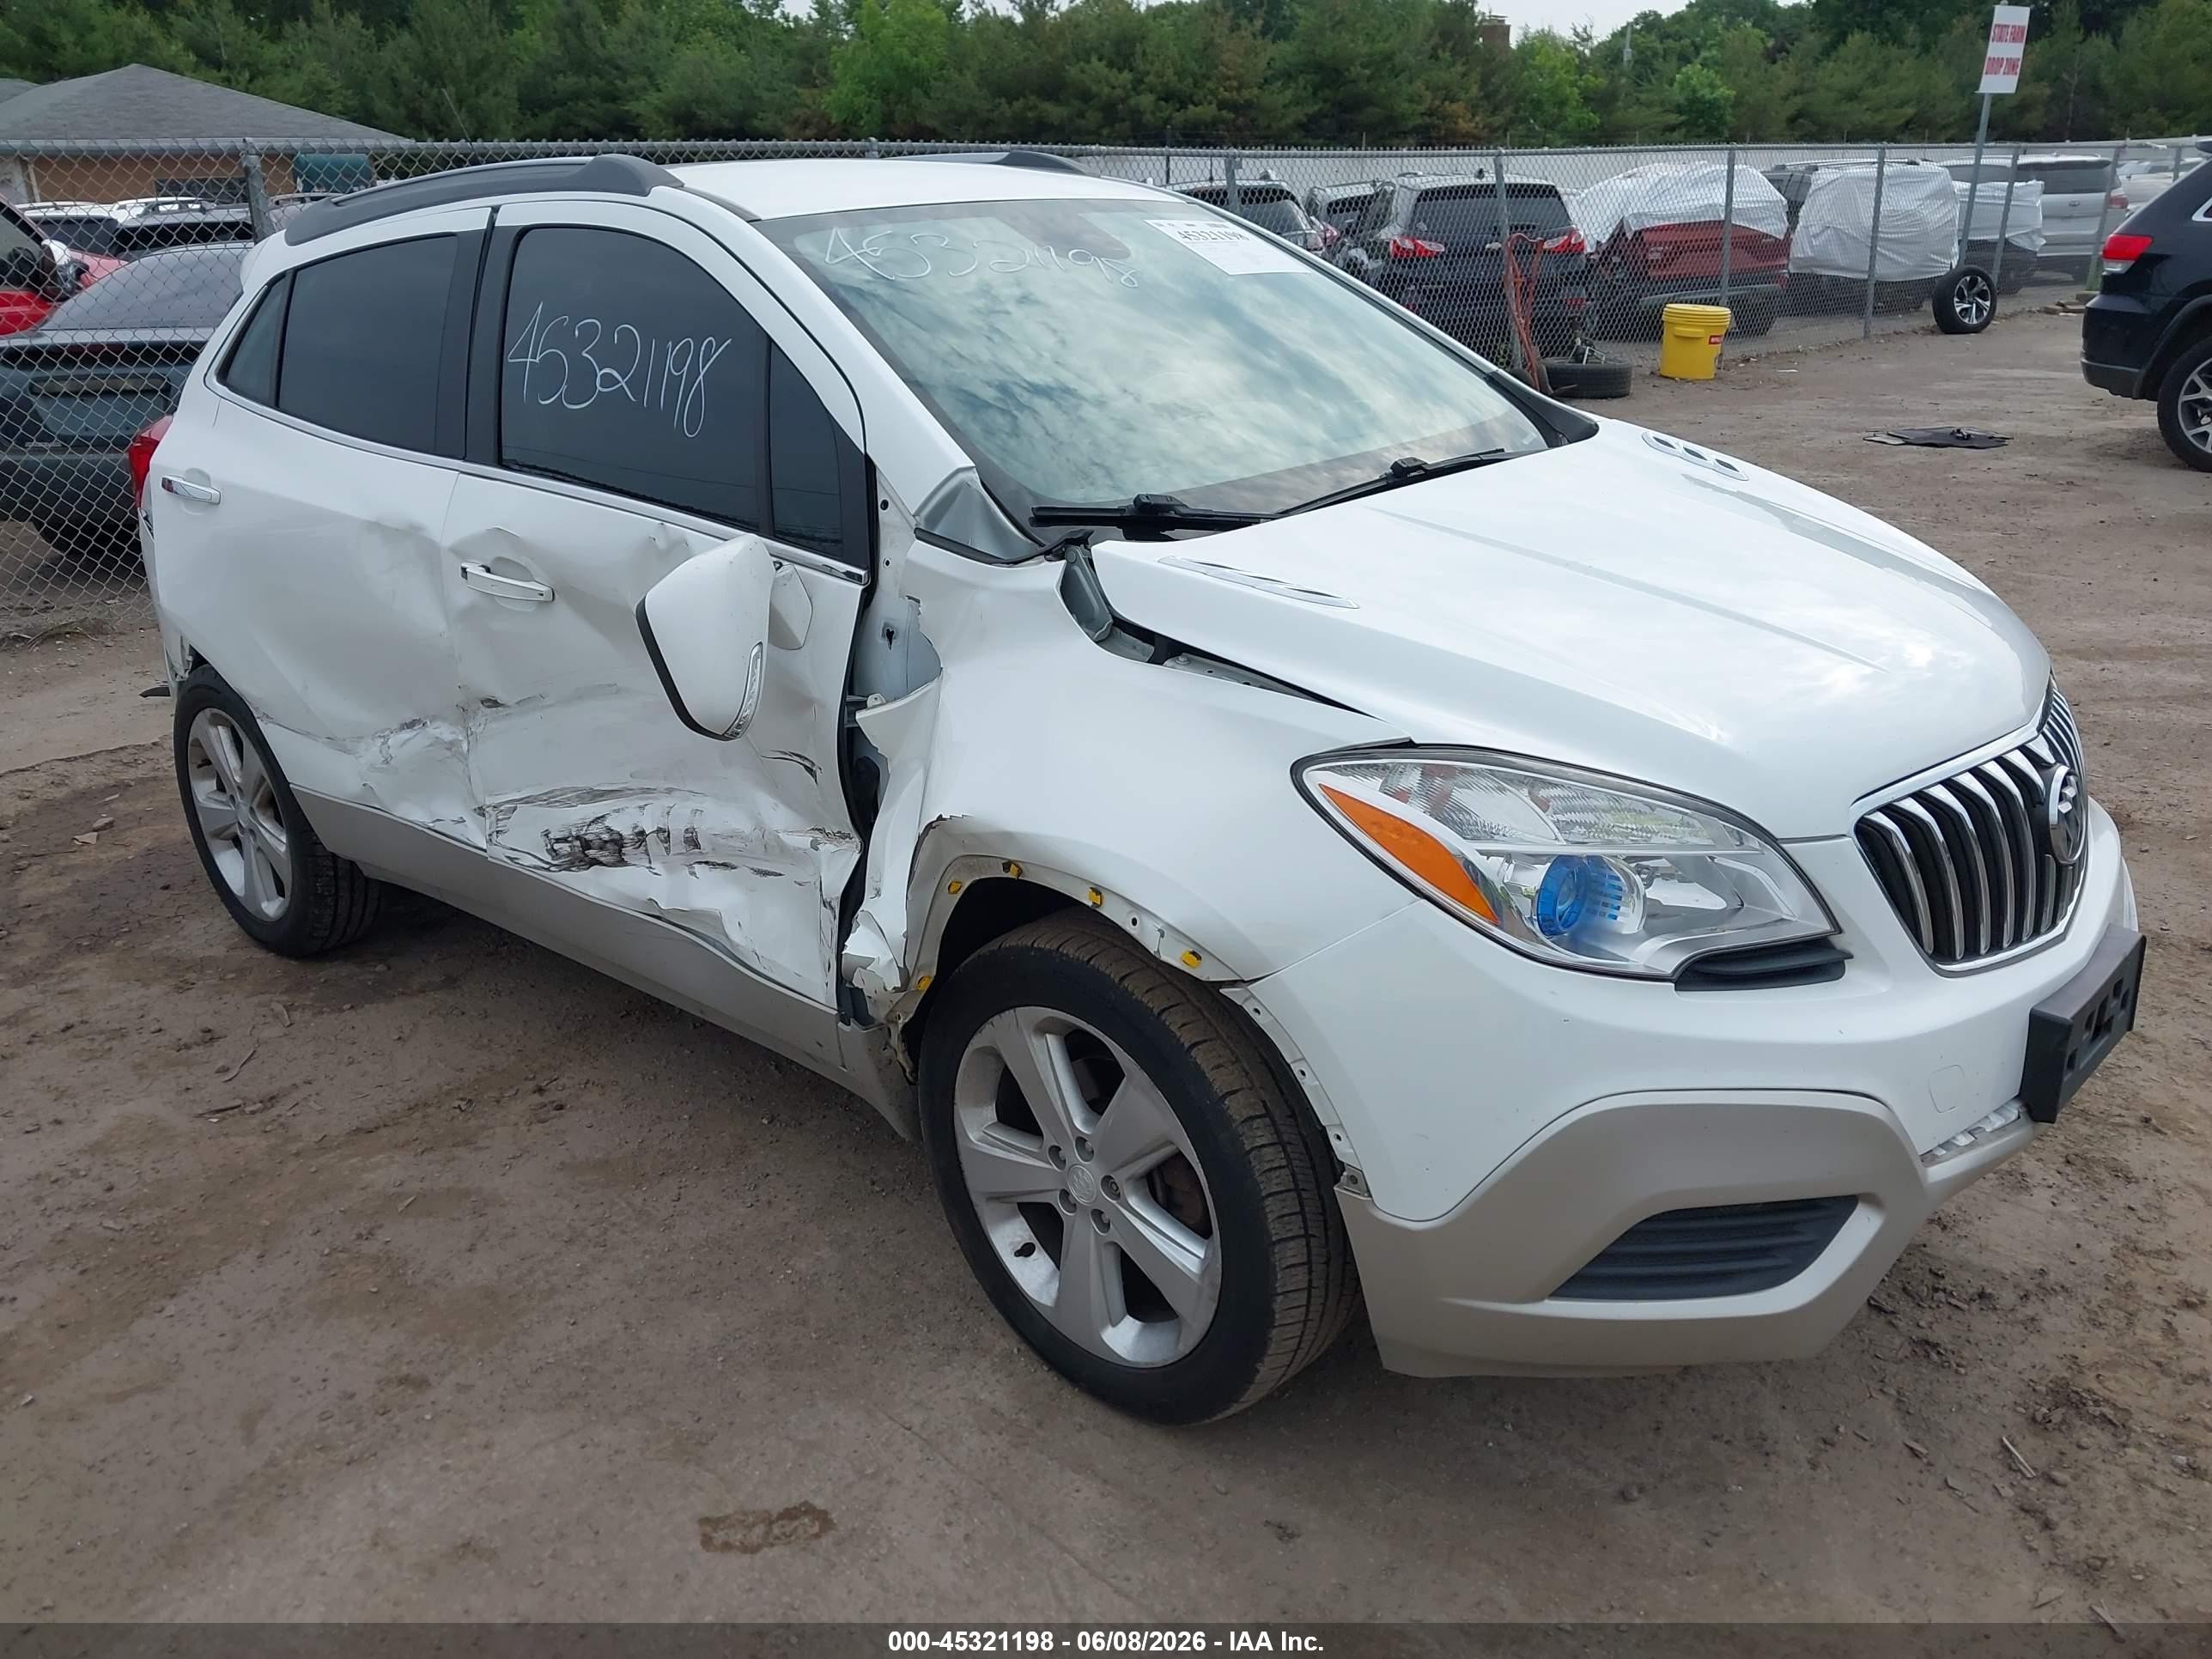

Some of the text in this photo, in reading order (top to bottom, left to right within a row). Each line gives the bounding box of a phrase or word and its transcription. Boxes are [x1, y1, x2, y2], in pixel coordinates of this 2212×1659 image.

[1992, 23, 2027, 43] STATE FARM
[1985, 57, 2021, 76] DROP ZONE
[824, 226, 1141, 289] 45321198
[507, 301, 732, 438] 45321198
